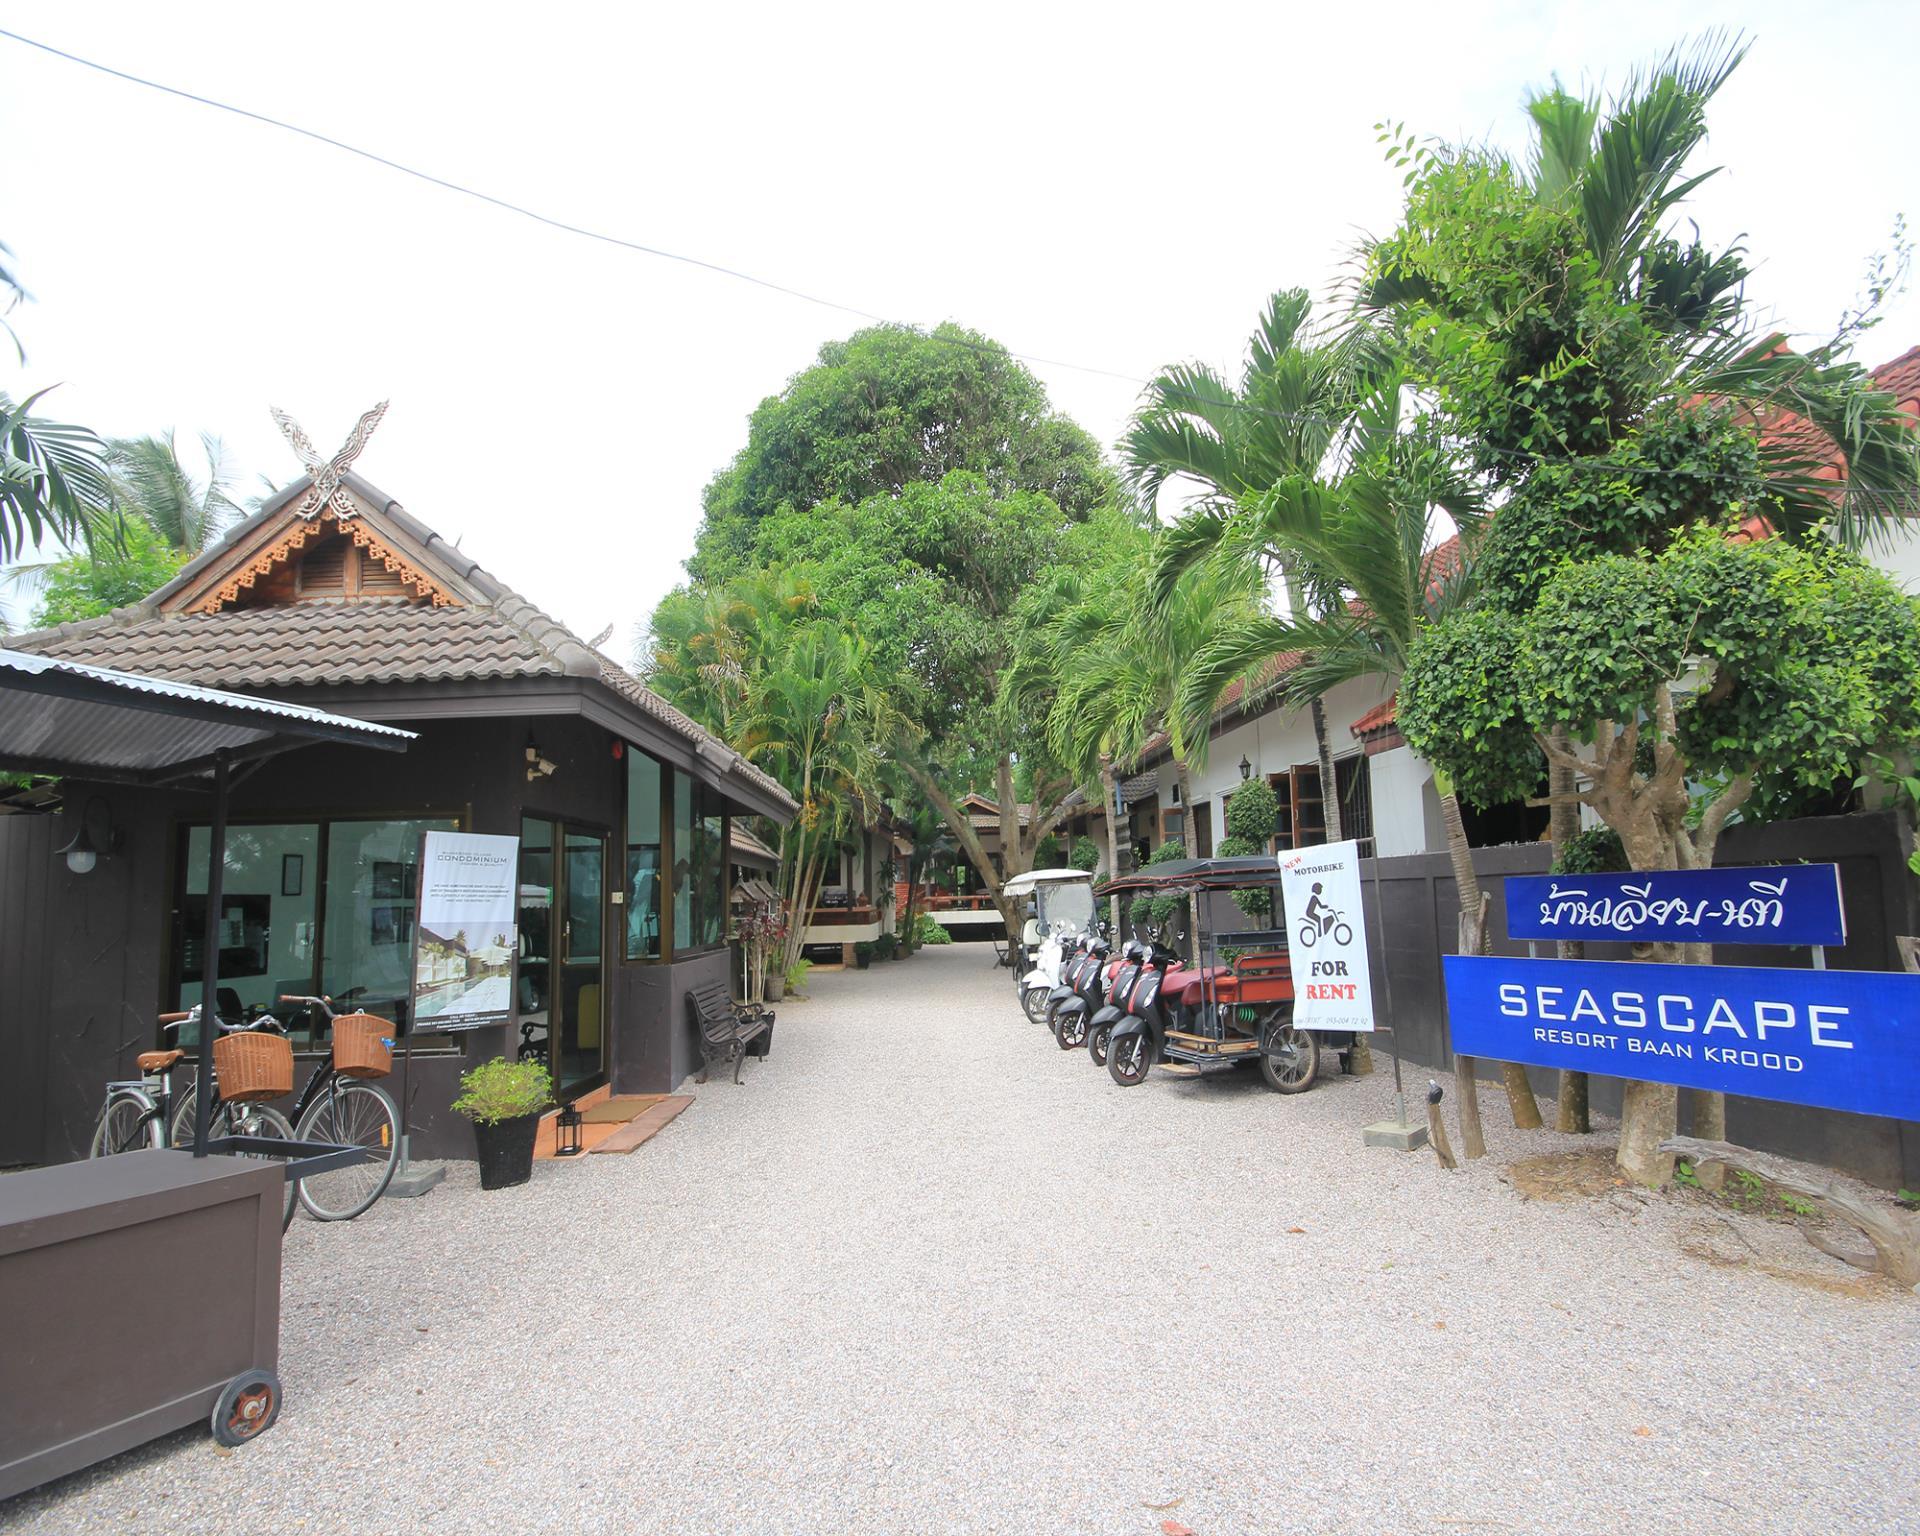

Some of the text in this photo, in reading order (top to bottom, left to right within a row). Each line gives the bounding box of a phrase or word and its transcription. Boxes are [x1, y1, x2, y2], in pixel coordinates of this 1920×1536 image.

[437, 854, 508, 863] CONDOMINIUM
[1284, 856, 1302, 870] NEW
[1294, 862, 1345, 876] MOTORBIKE
[1311, 960, 1349, 976] FOR
[1306, 983, 1357, 1000] RENT
[1498, 983, 1854, 1049] SEASCAPE
[1533, 1027, 1804, 1072] RESORT BAAN KROOD
